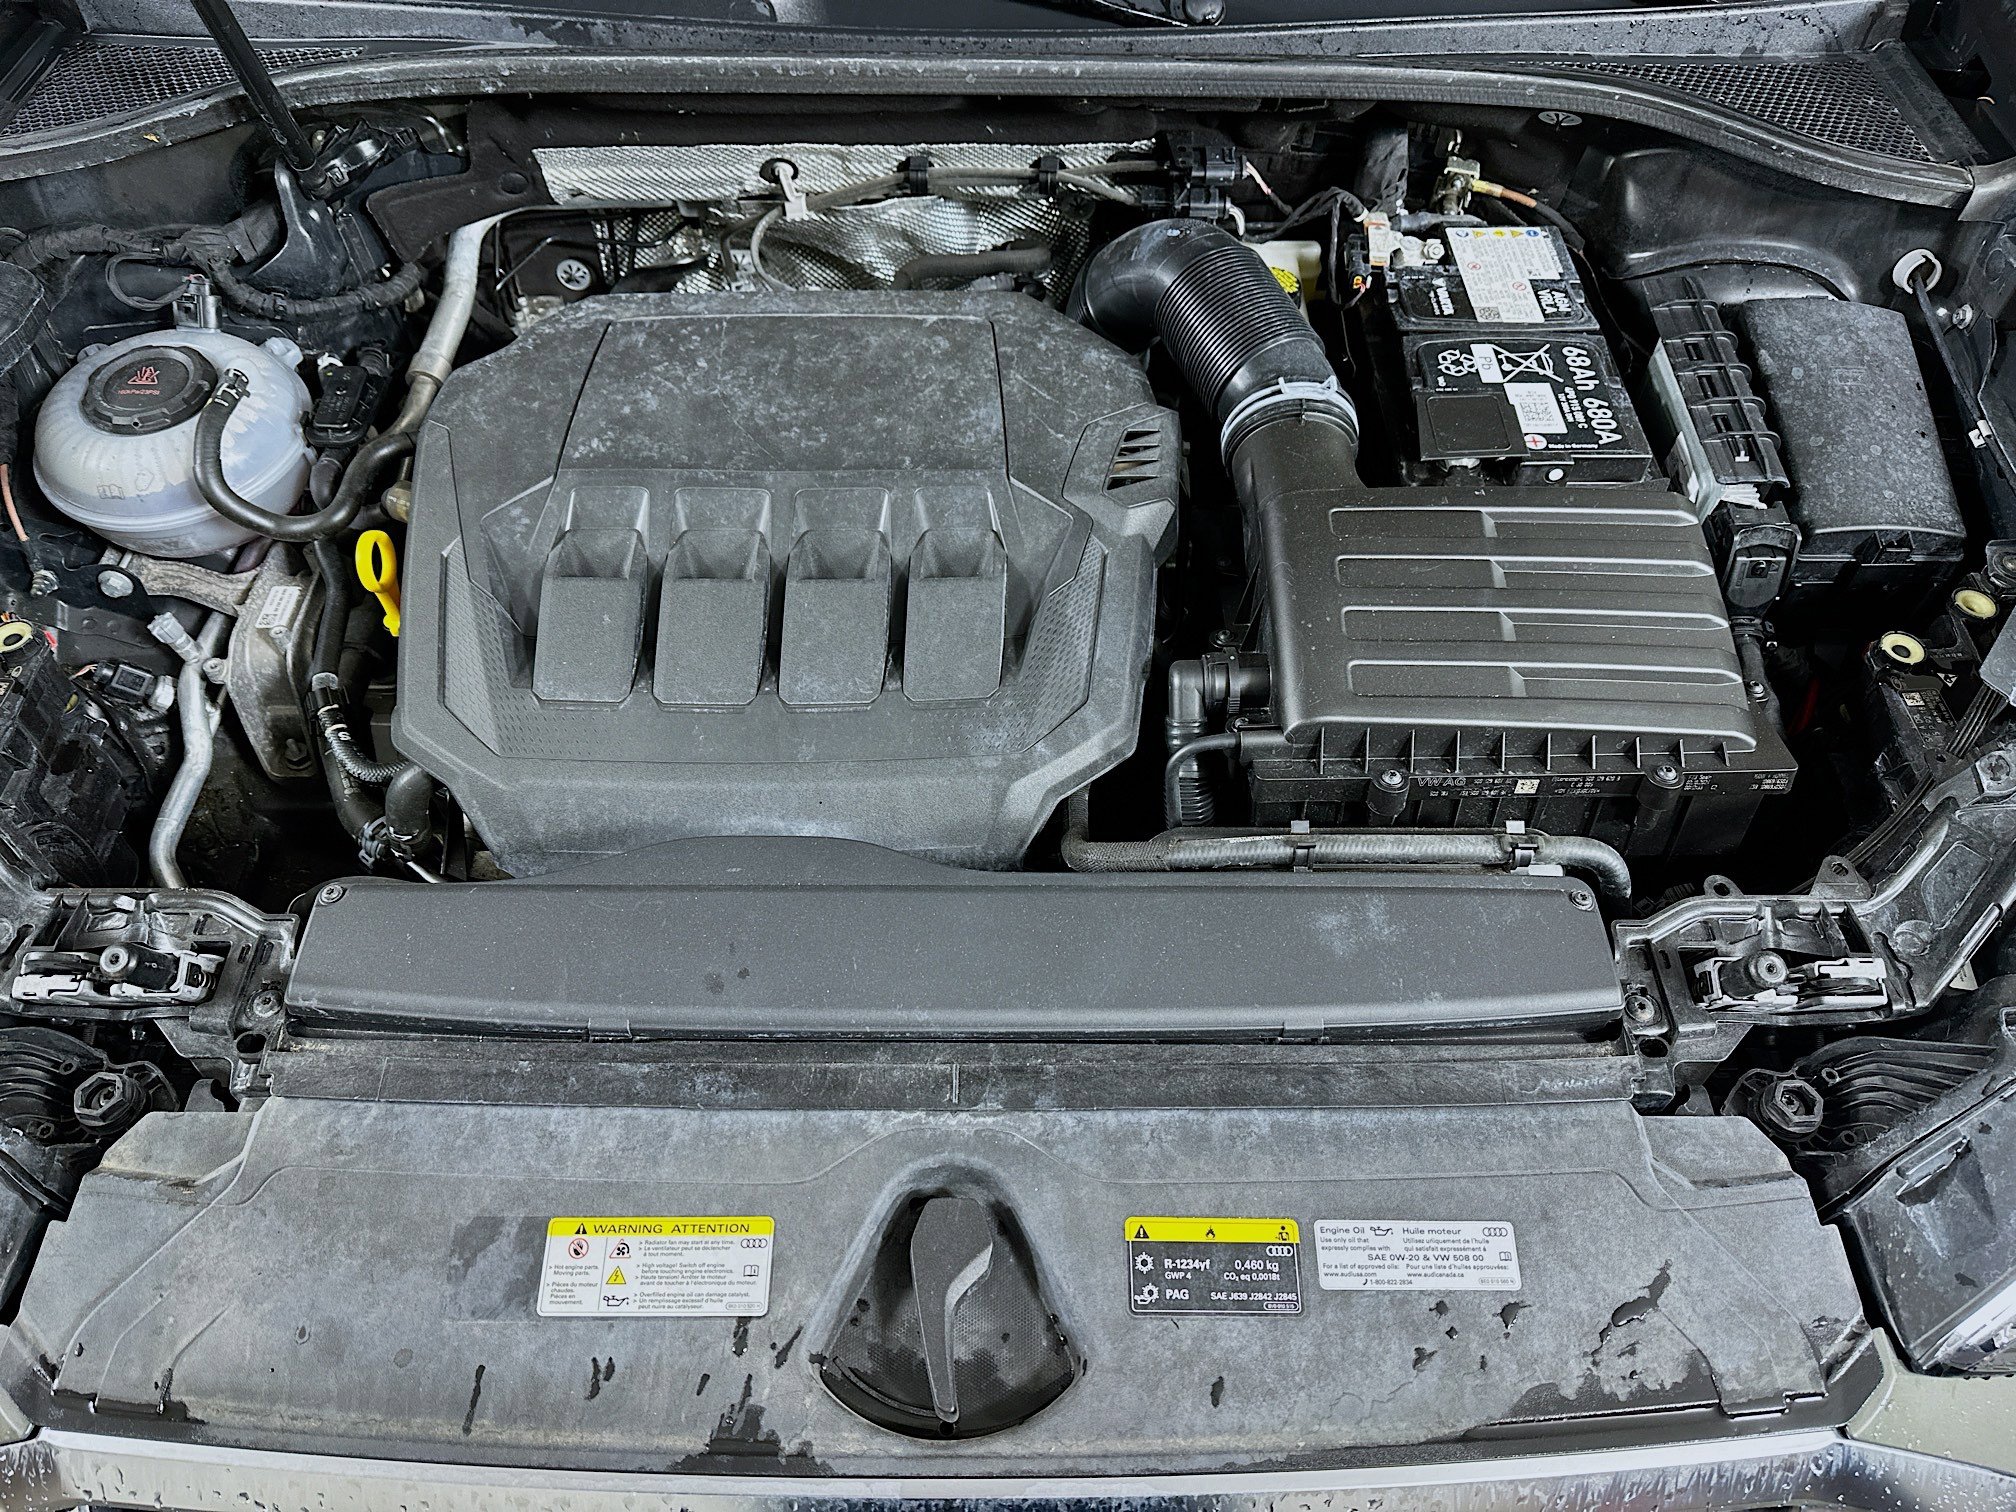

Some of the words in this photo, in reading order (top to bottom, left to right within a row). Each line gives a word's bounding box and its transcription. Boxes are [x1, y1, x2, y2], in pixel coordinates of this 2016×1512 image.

[1538, 289, 1558, 314] VRLA
[1551, 291, 1572, 312] AGM
[1482, 357, 1492, 371] Pb
[1562, 346, 1600, 391] 68Ah
[1583, 397, 1622, 444] 680A
[1418, 777, 1442, 786] VW
[1443, 777, 1466, 786] AG
[594, 1224, 663, 1233] WARNING
[671, 1224, 750, 1233] ATTENTION
[1164, 1259, 1210, 1271] R-1234yf
[1234, 1260, 1263, 1270] 0,460
[1266, 1260, 1279, 1271] kg
[1166, 1289, 1189, 1299] PAG
[1210, 1292, 1227, 1300] SAE
[1273, 1293, 1297, 1301] J2845
